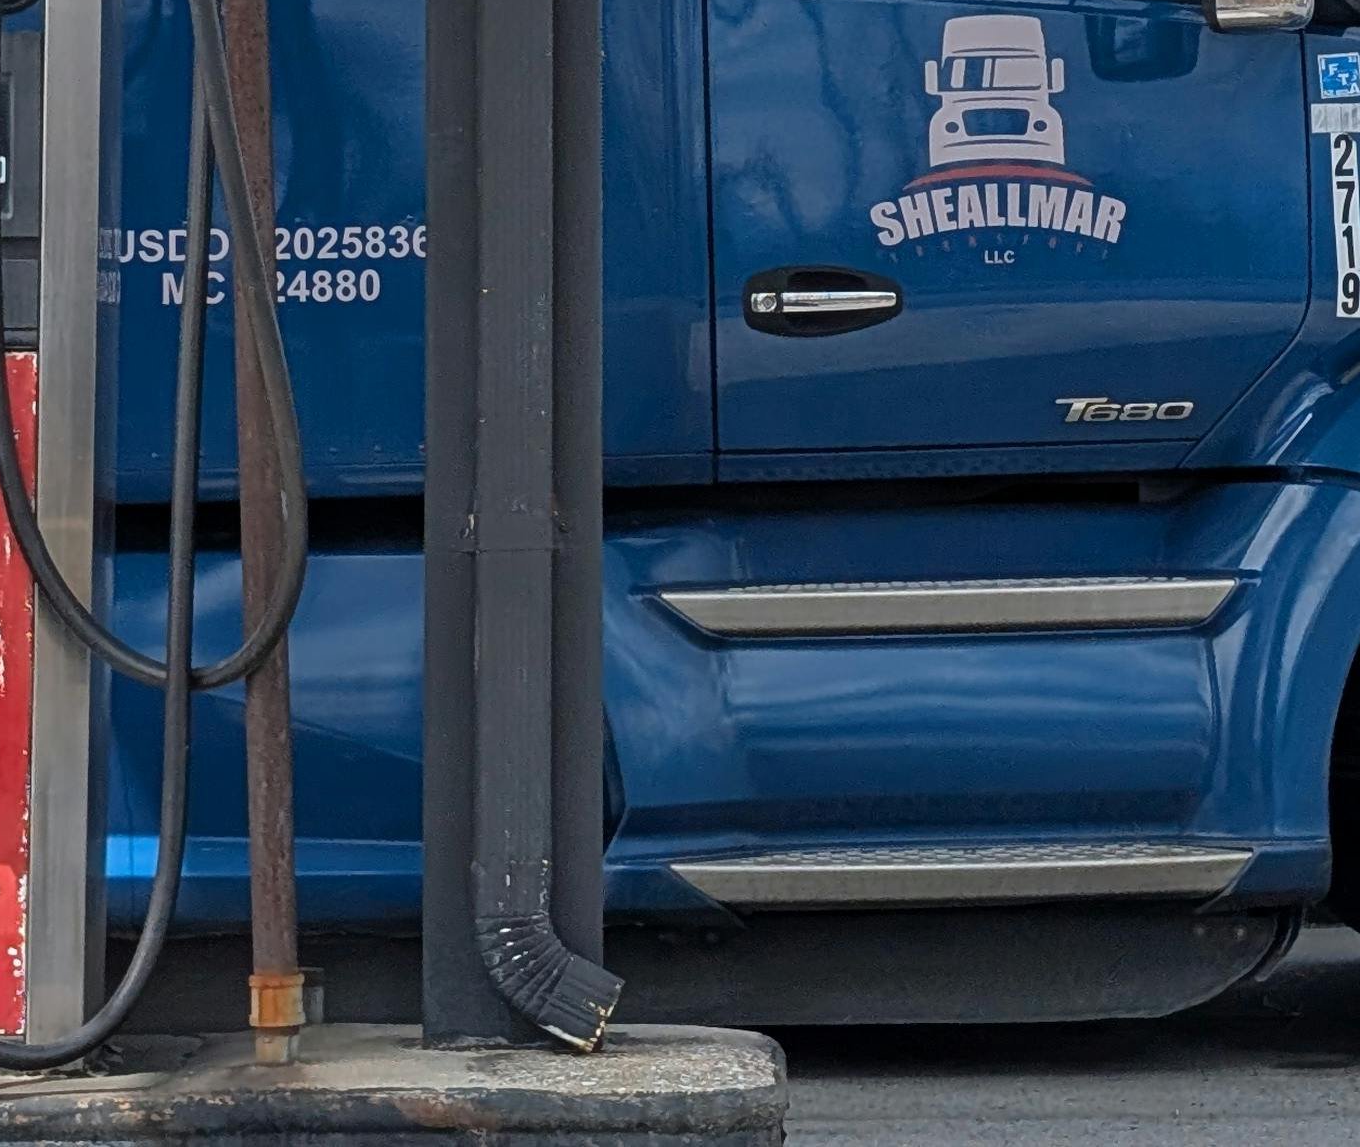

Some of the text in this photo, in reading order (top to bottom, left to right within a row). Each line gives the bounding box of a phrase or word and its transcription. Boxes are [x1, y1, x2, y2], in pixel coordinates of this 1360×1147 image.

[869, 183, 1127, 246] SHEALLMAR
[1333, 133, 1360, 316] 2719
[984, 250, 1016, 264] LLC
[1055, 397, 1194, 423] T680
